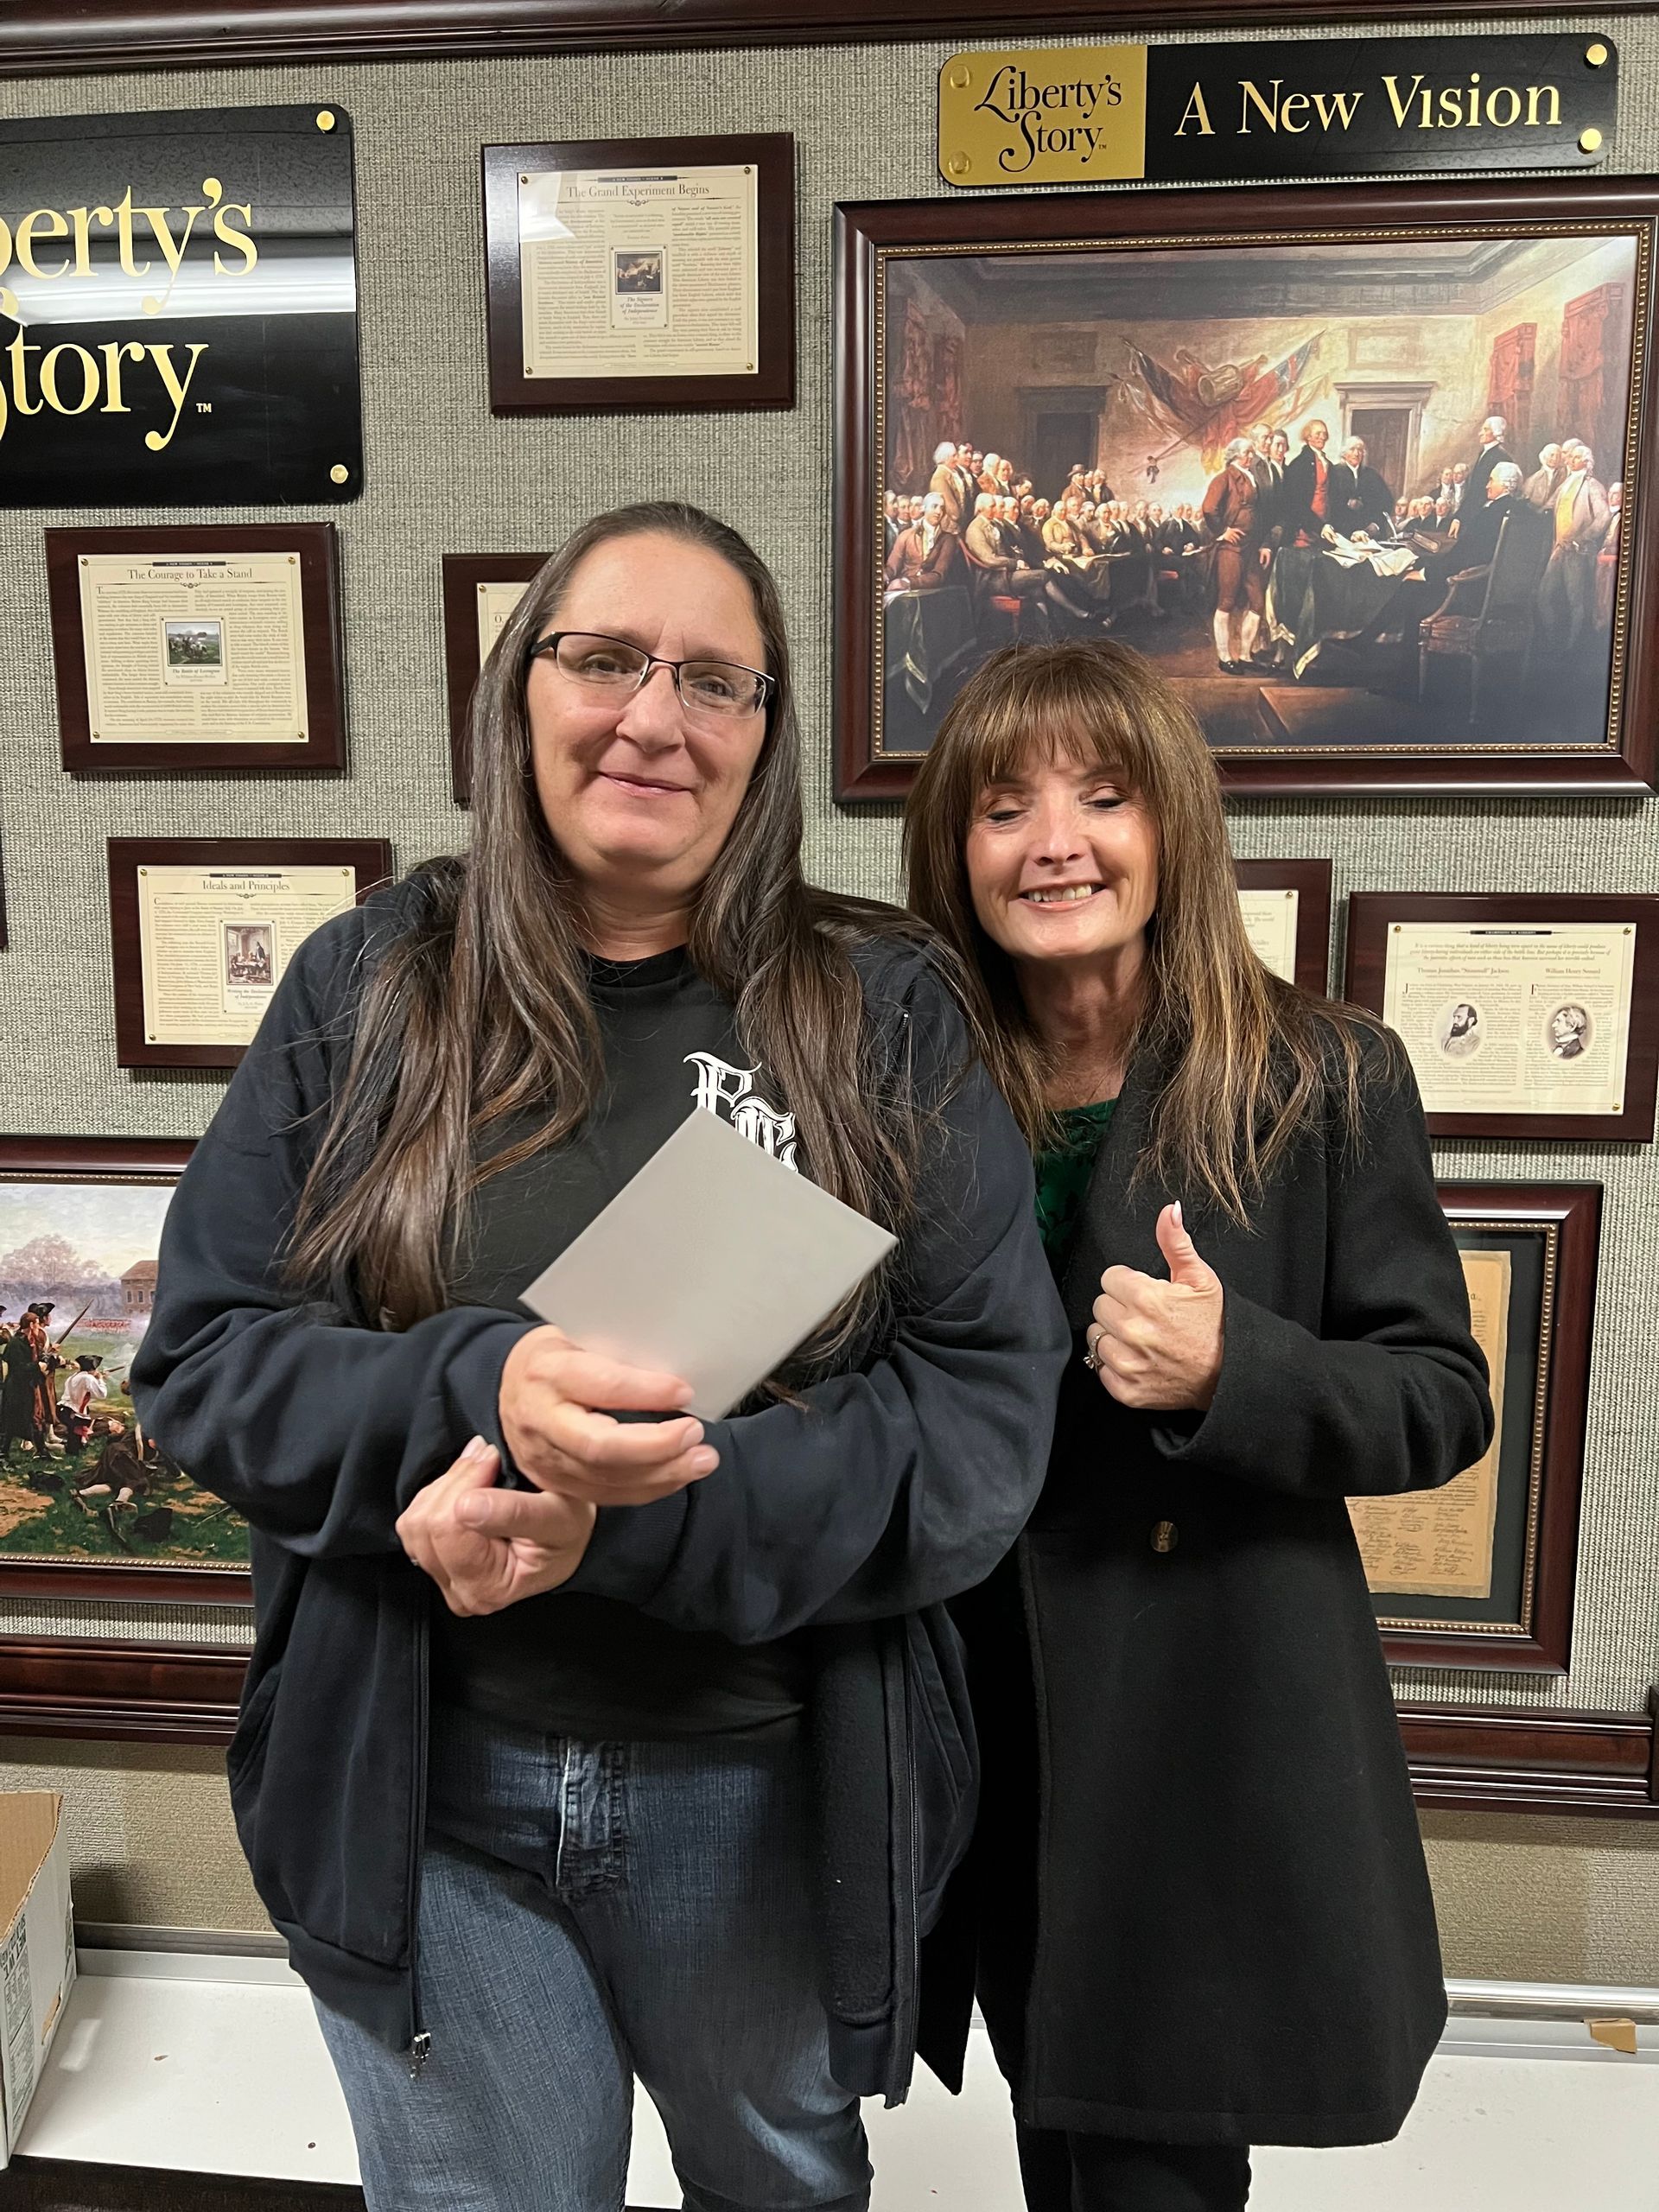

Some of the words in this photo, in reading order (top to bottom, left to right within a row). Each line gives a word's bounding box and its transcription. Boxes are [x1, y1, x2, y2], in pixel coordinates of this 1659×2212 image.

[974, 66, 1122, 123] Liberty's
[1174, 81, 1216, 136] A
[1236, 79, 1363, 133] New
[1381, 73, 1562, 129] Vision
[999, 111, 1103, 172] Story
[566, 186, 587, 198] The
[588, 185, 620, 198] Grand
[621, 184, 676, 200] Experiment
[678, 183, 710, 197] Begins
[0, 177, 257, 315] erty's
[0, 286, 209, 451] tory
[127, 569, 146, 580] The
[148, 568, 184, 582] Courage
[186, 570, 194, 579] to
[196, 568, 218, 579] Take
[226, 568, 252, 579] Stand
[202, 880, 227, 890] Ideals
[229, 880, 245, 890] and
[248, 880, 290, 893] Principles
